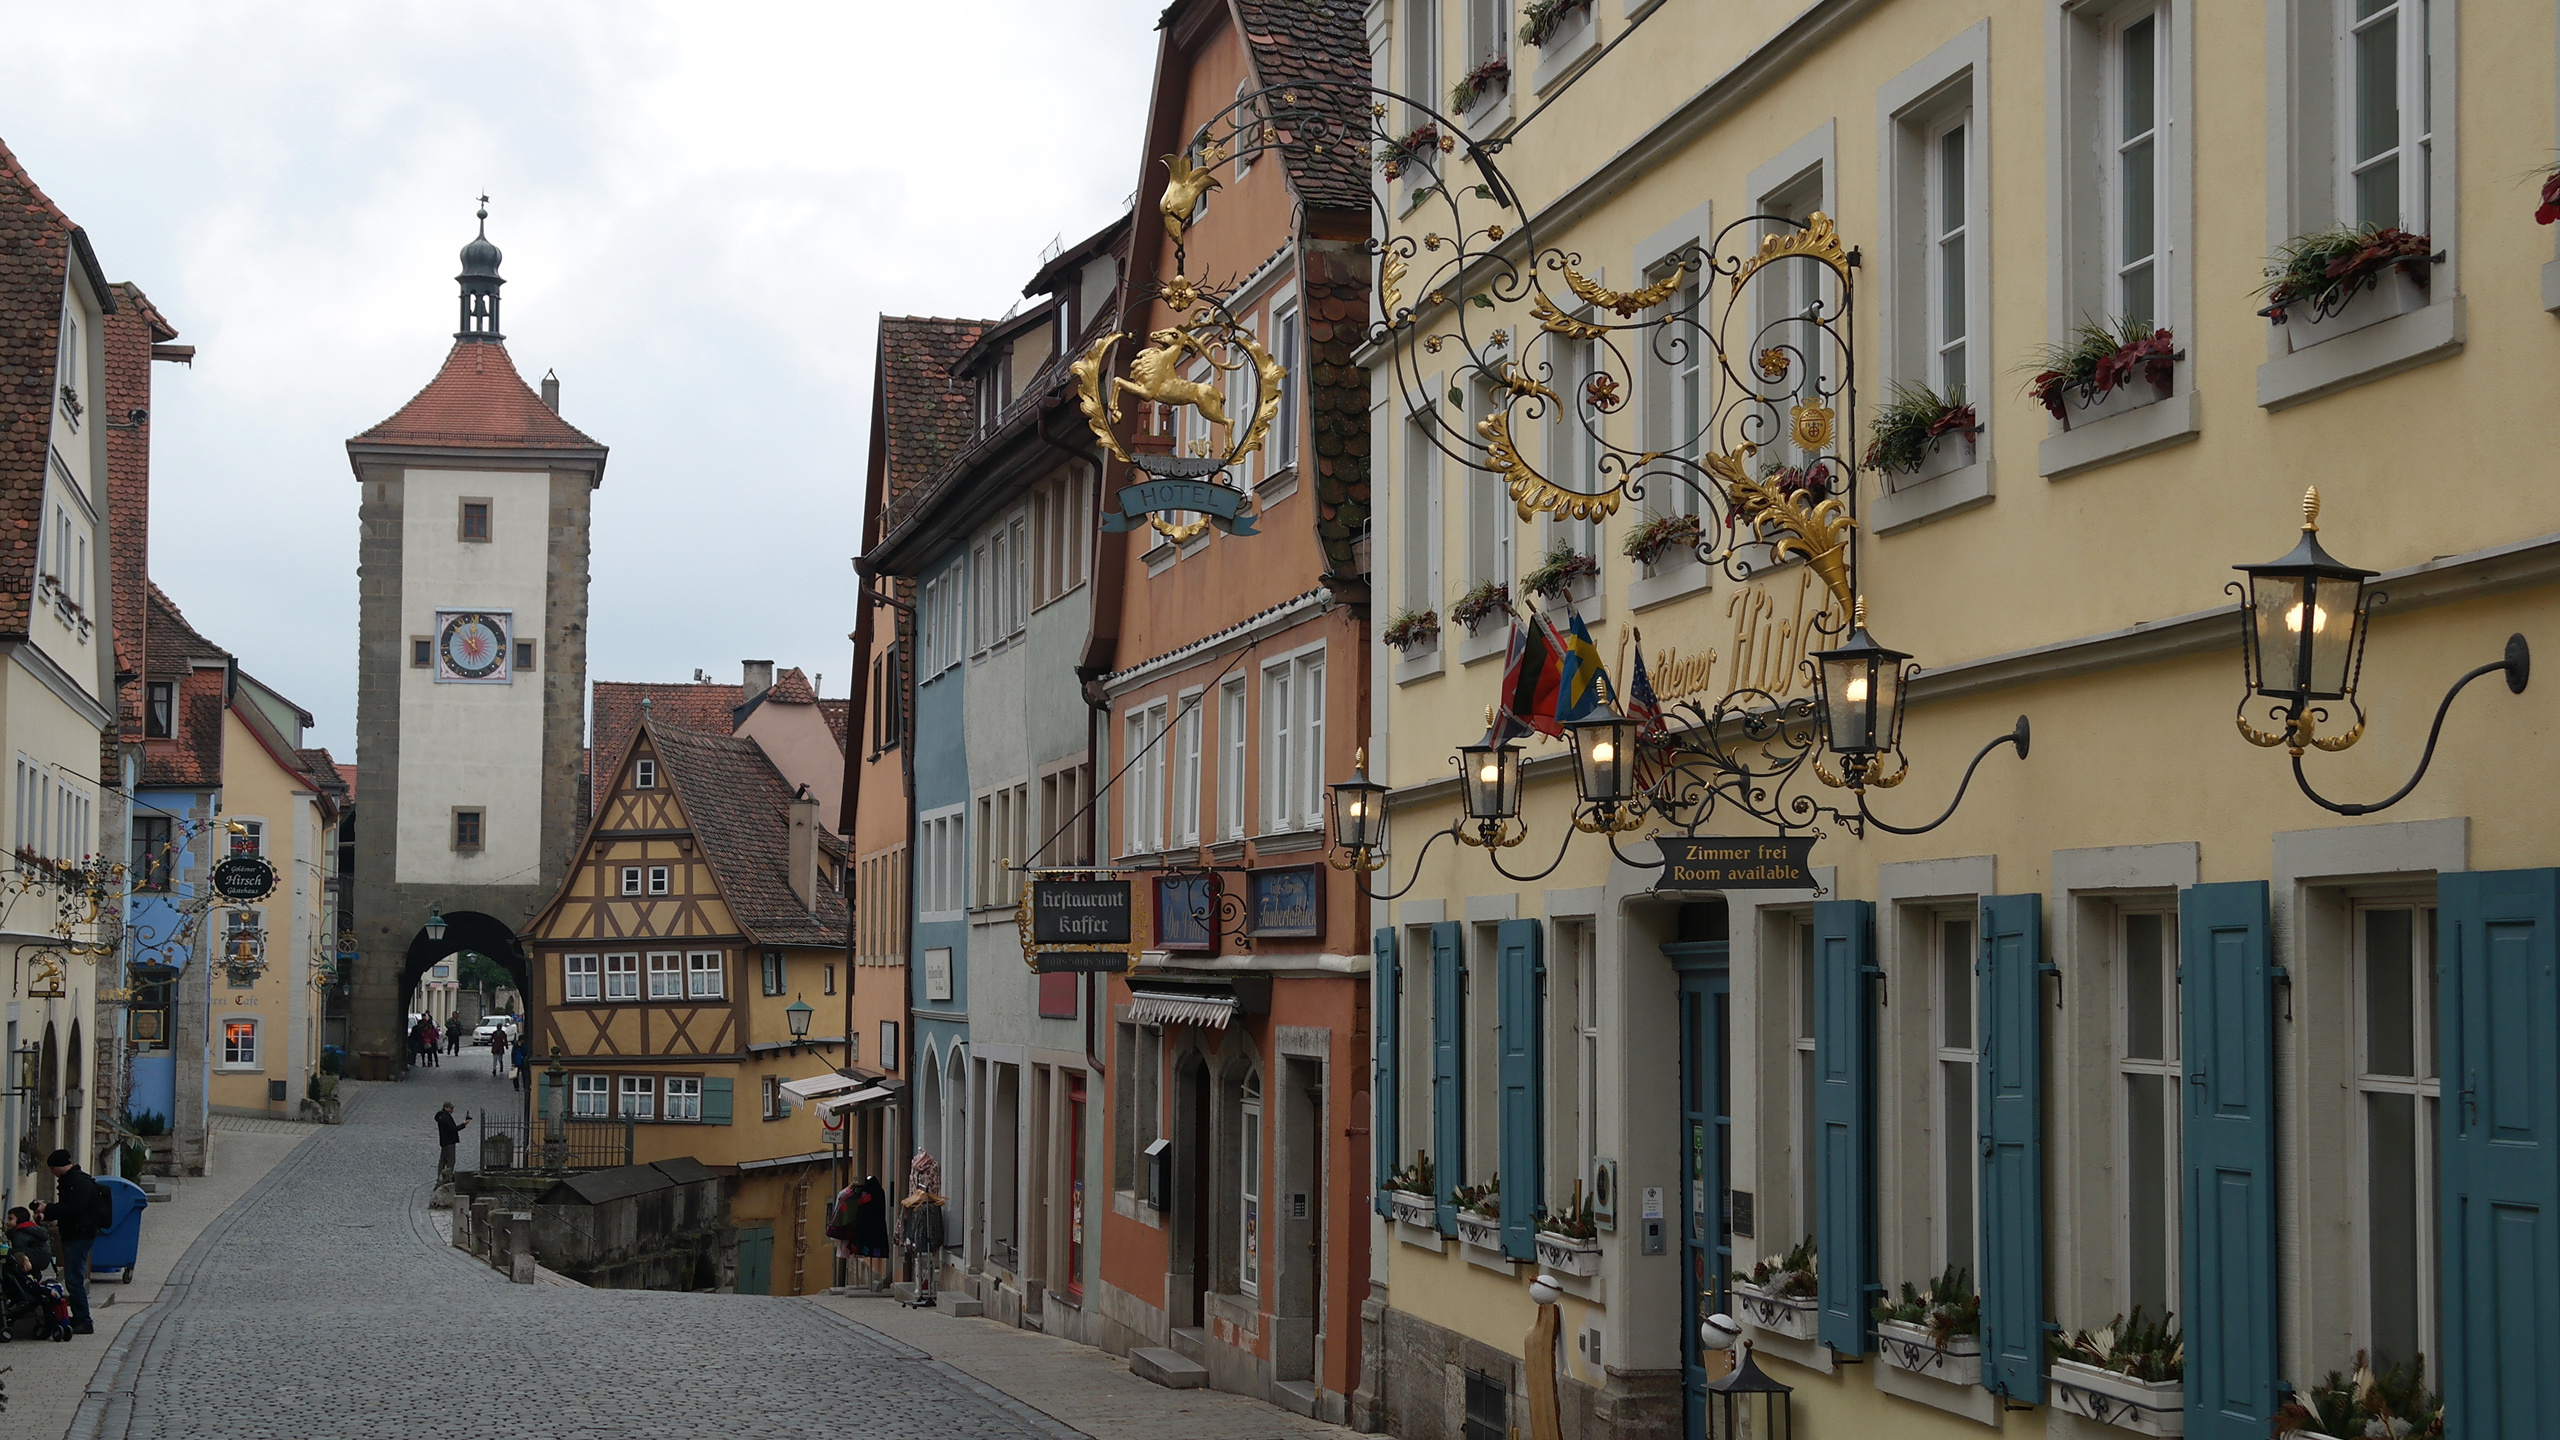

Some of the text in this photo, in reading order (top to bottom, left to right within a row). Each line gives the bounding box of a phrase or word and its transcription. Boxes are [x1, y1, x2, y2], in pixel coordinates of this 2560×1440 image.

[1141, 485, 1218, 507] HOTEL
[1685, 844, 1787, 860] Zimmer frei
[230, 865, 257, 874] Goldener
[1673, 864, 1800, 881] Room available
[224, 873, 262, 886] Hirsch
[226, 886, 259, 895] Gästehaus
